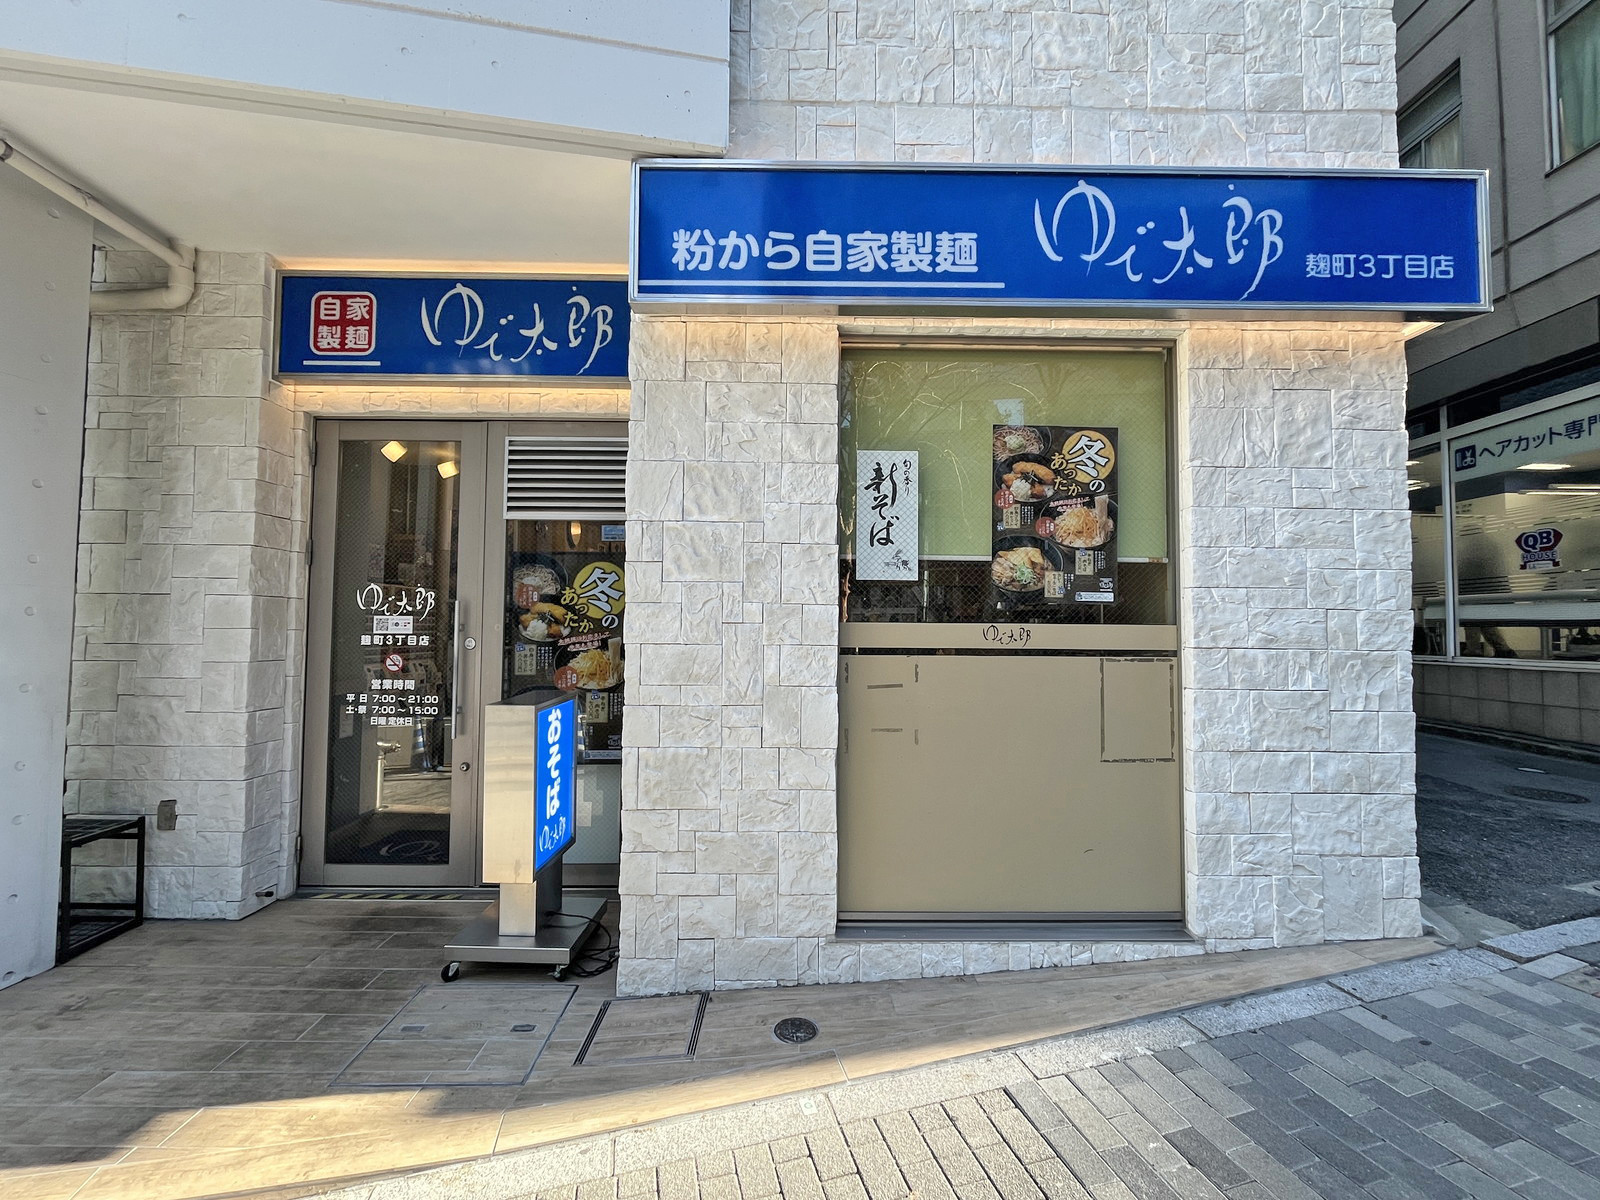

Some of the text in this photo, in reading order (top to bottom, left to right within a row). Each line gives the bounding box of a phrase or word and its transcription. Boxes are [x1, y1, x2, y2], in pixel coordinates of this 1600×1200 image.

[672, 228, 978, 273] 粉から自家製麺
[1033, 179, 1284, 302] ゆで太郎
[1305, 253, 1454, 280] 麹町3丁目店
[319, 296, 370, 321] 自家
[317, 325, 369, 350] 製麺
[420, 282, 614, 376] ゆで太郎
[1521, 529, 1554, 551] QB
[1522, 550, 1557, 561] HOUSE
[356, 583, 436, 622] ゆで太郎
[982, 624, 1031, 648] ゆで太郎
[371, 679, 415, 690] 営業時間
[546, 708, 562, 819] おそば
